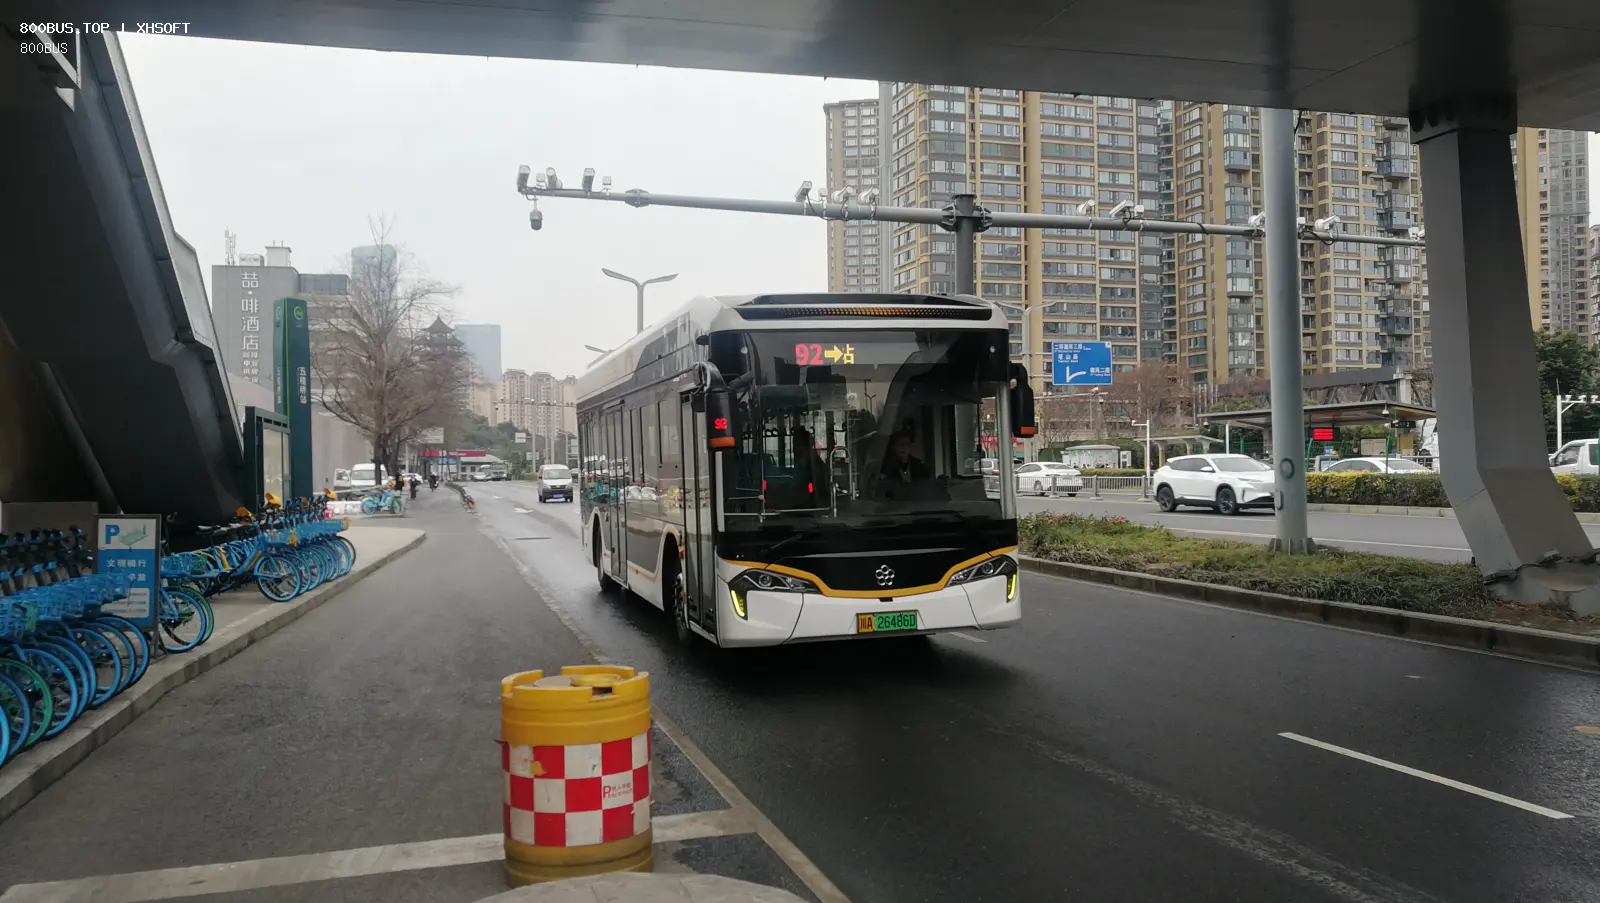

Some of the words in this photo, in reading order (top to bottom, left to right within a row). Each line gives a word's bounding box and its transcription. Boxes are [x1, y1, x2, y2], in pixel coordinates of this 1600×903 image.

[795, 343, 824, 365] 92
[714, 417, 728, 430] 92
[104, 524, 120, 545] P
